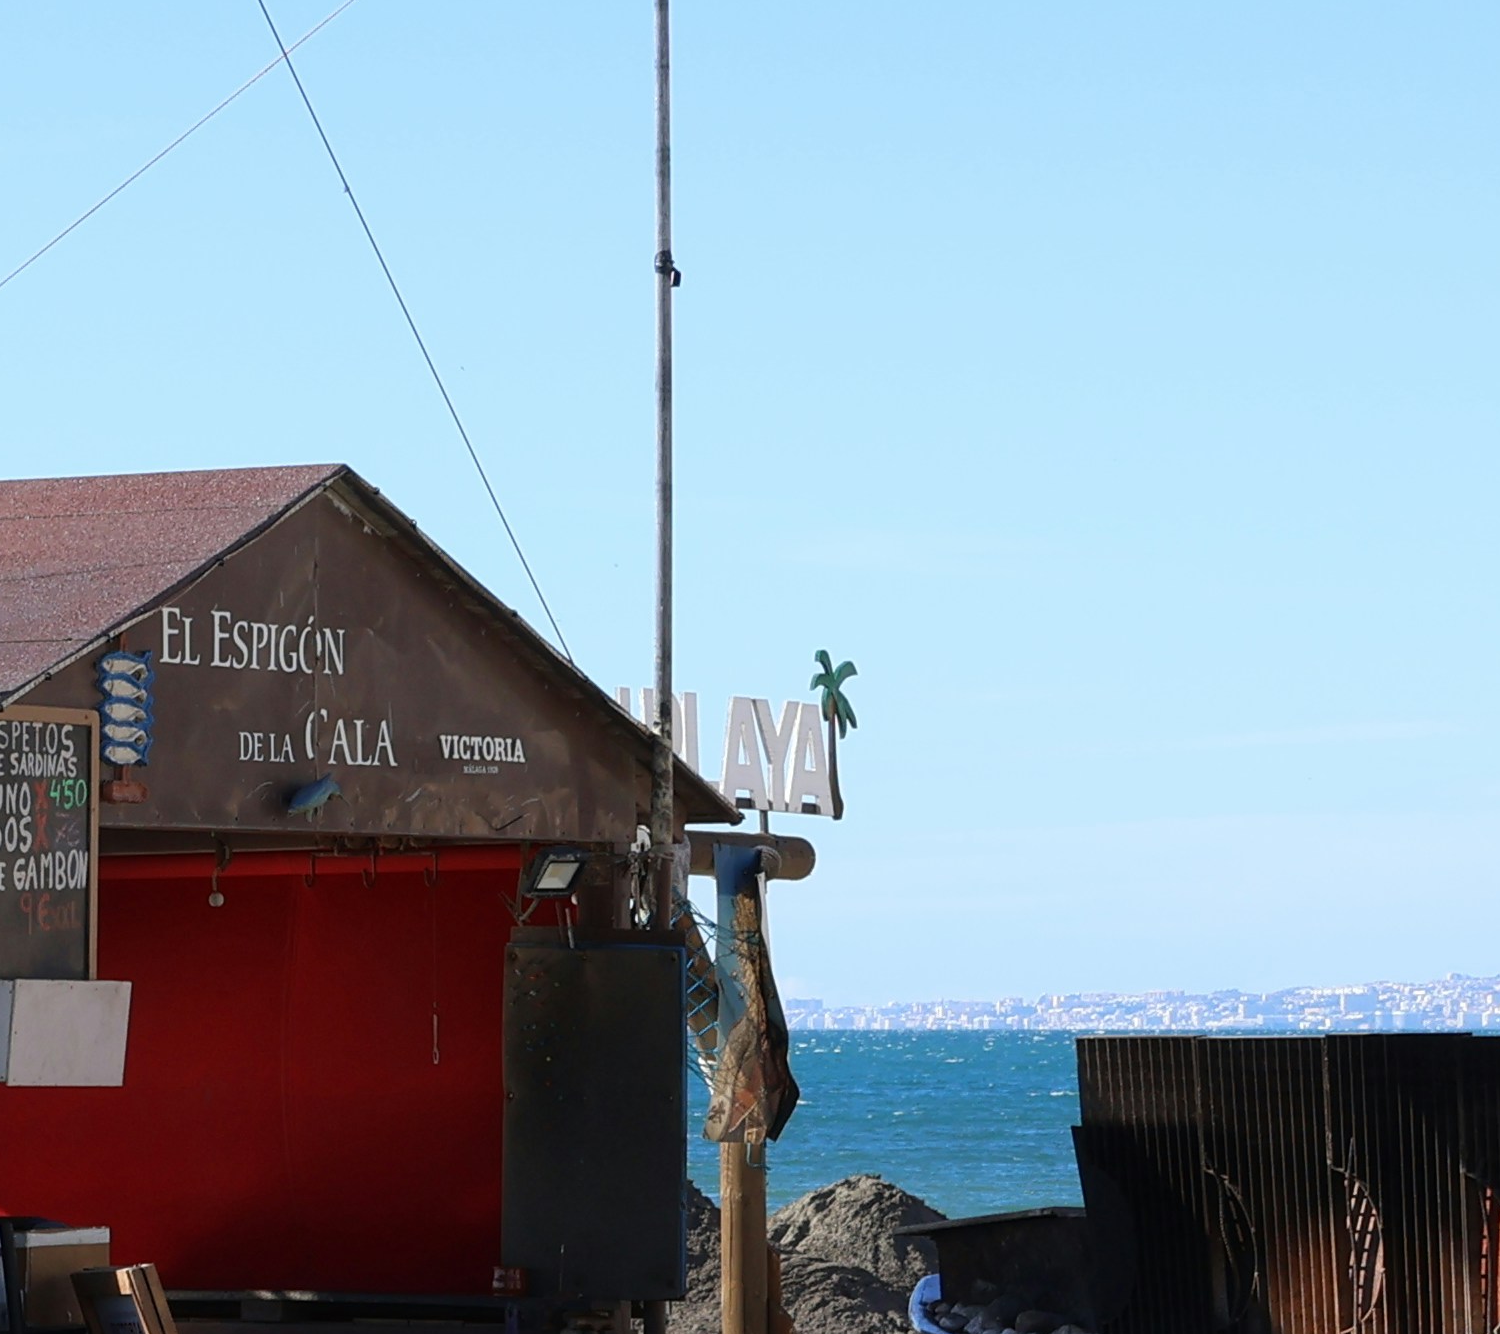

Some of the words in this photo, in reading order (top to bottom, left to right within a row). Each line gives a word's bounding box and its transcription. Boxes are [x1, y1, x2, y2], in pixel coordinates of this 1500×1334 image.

[159, 606, 201, 666] EL
[210, 609, 346, 676] ESPIGÓN
[238, 731, 265, 763] DE
[268, 733, 296, 764] LA
[304, 708, 398, 767] CALA
[438, 734, 527, 764] VICTORIA
[10, 752, 78, 778] SARDINAS
[13, 848, 89, 891] GAMBON
